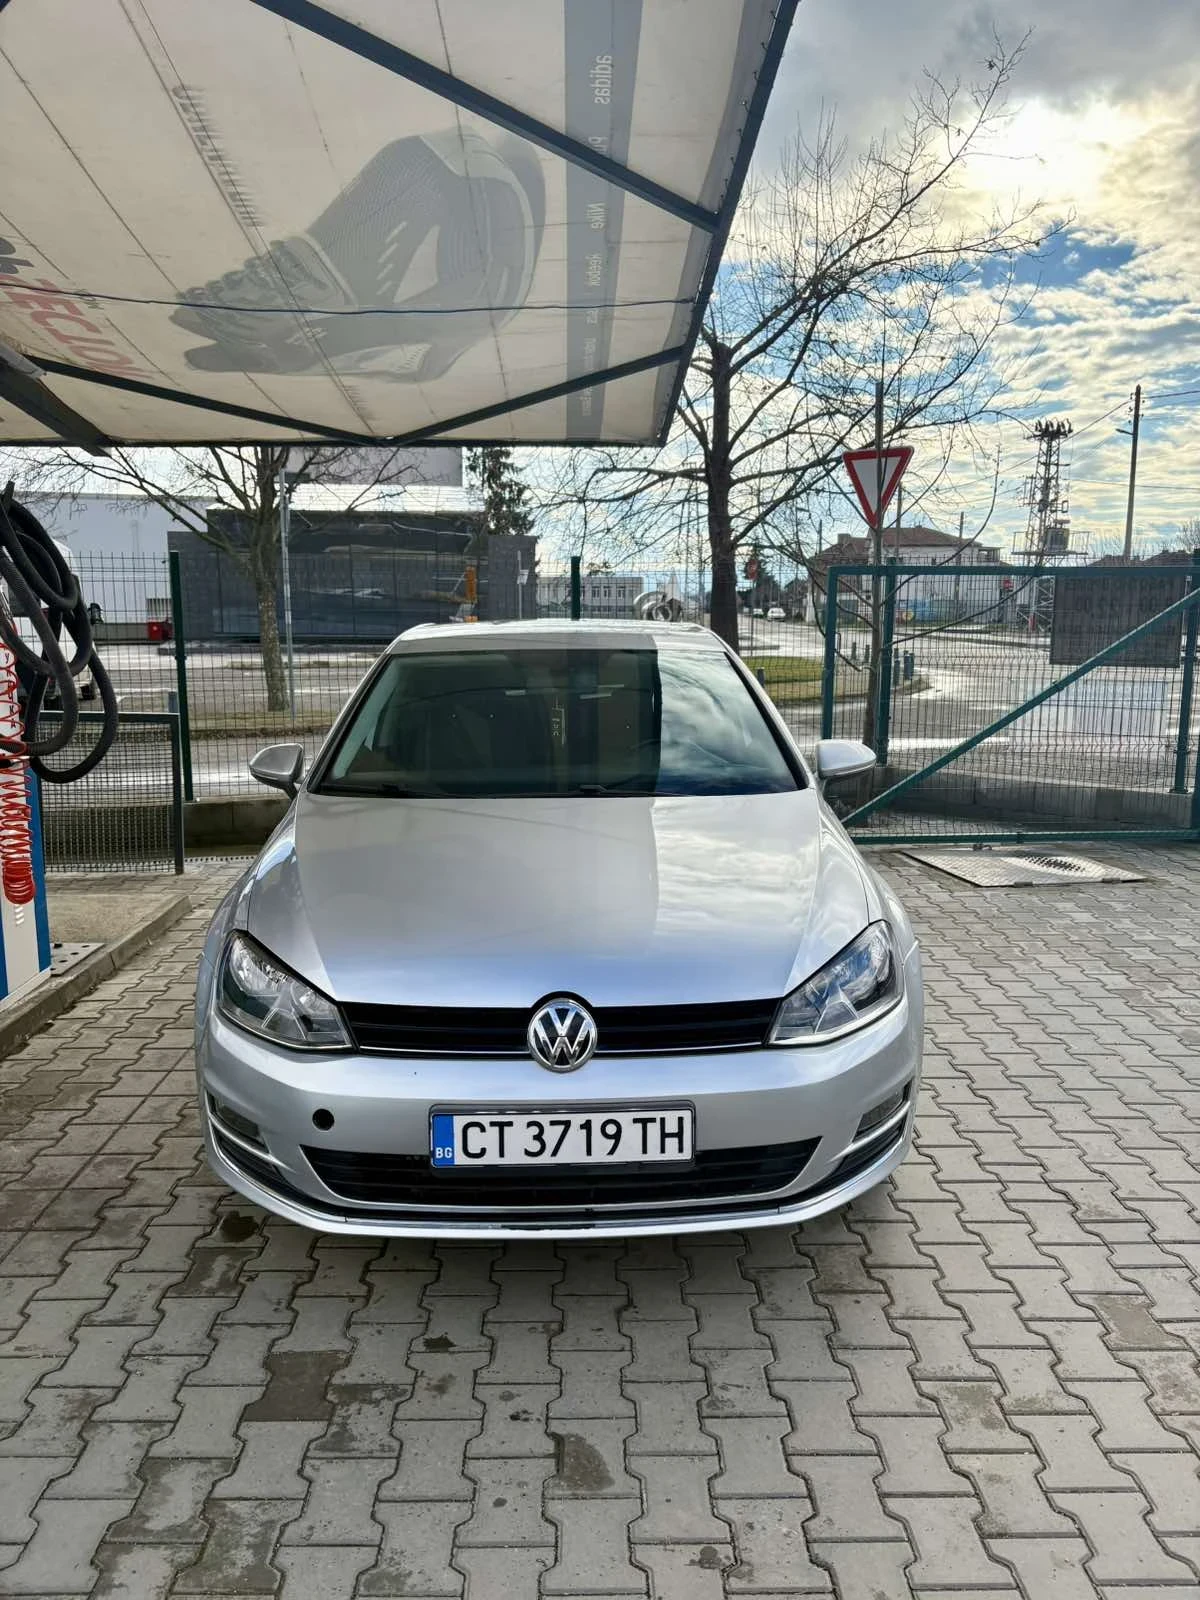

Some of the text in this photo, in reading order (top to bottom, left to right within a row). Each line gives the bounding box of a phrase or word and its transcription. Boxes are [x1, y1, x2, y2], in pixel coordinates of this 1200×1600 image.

[531, 1004, 594, 1068] VW
[435, 1147, 453, 1159] BG
[461, 1115, 685, 1160] CT 3719 TH
